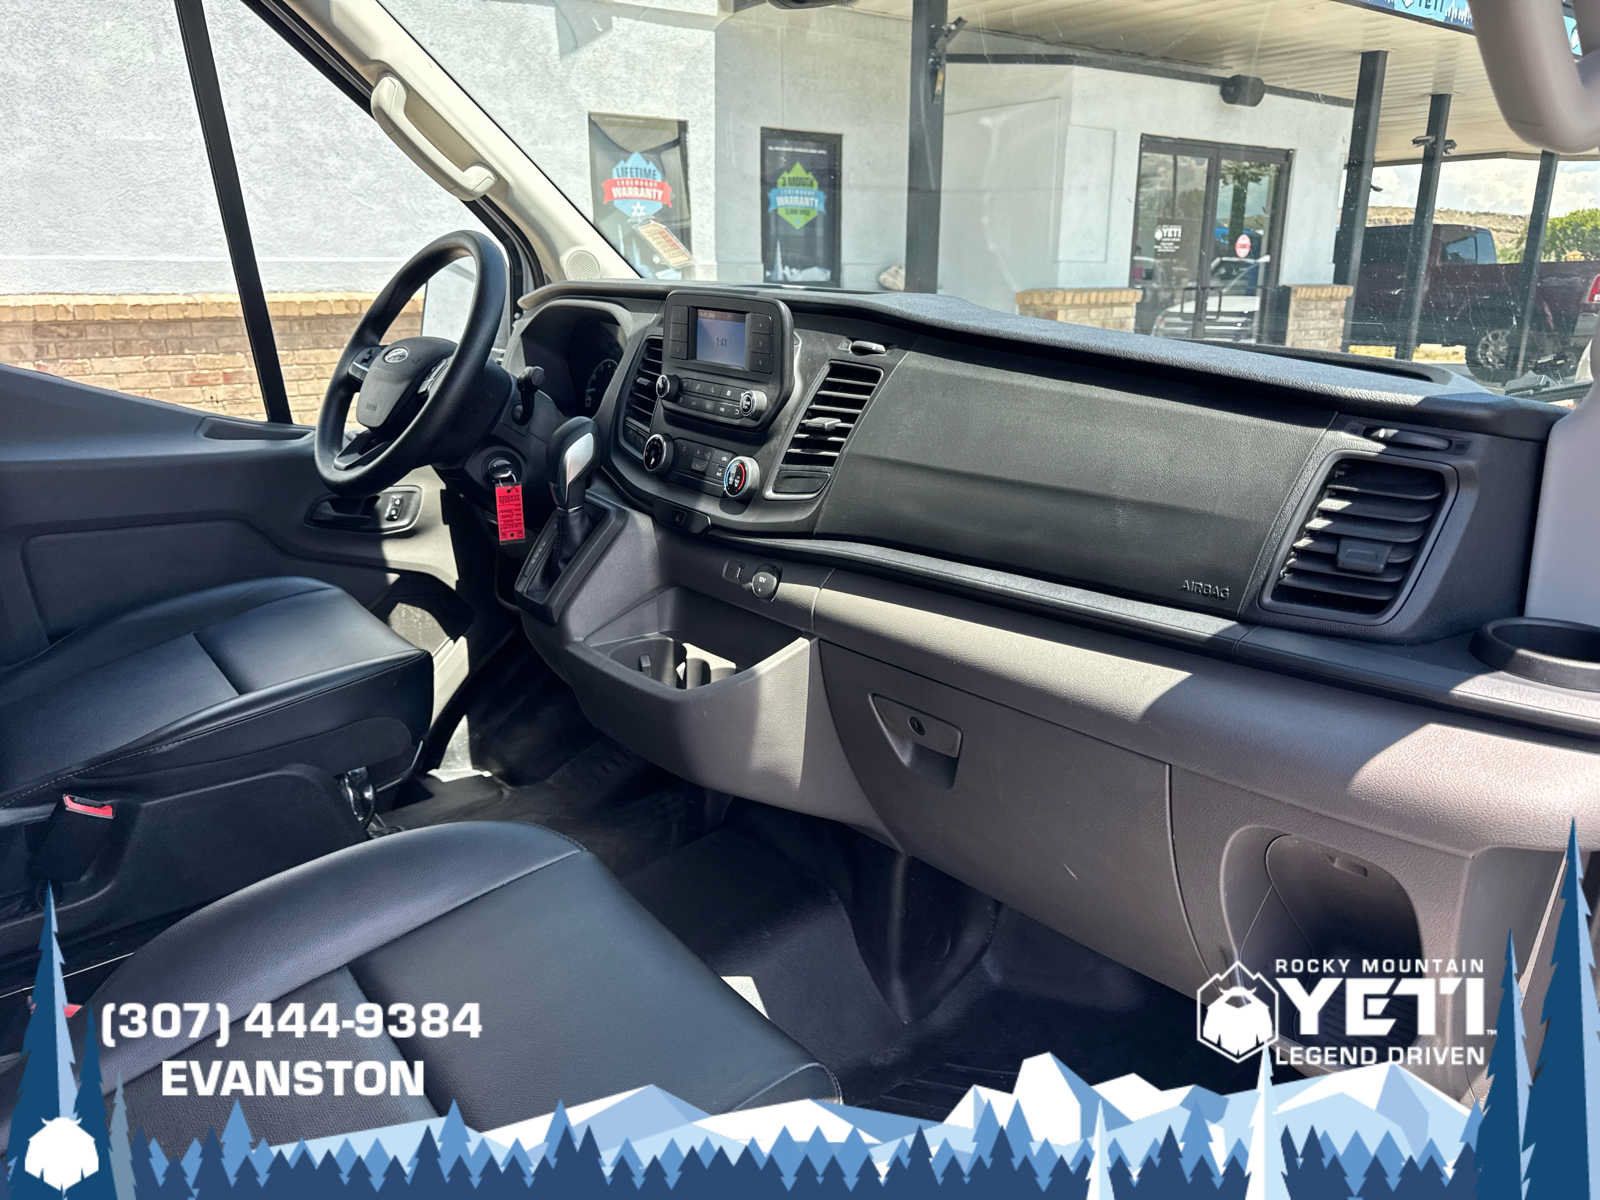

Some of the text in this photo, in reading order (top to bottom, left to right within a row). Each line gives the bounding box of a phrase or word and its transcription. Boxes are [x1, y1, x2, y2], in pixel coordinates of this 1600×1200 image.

[615, 166, 658, 179] LIFETIME
[611, 187, 664, 201] WARRANTY
[1162, 228, 1182, 238] YETI
[1180, 579, 1230, 600] AIRBAG
